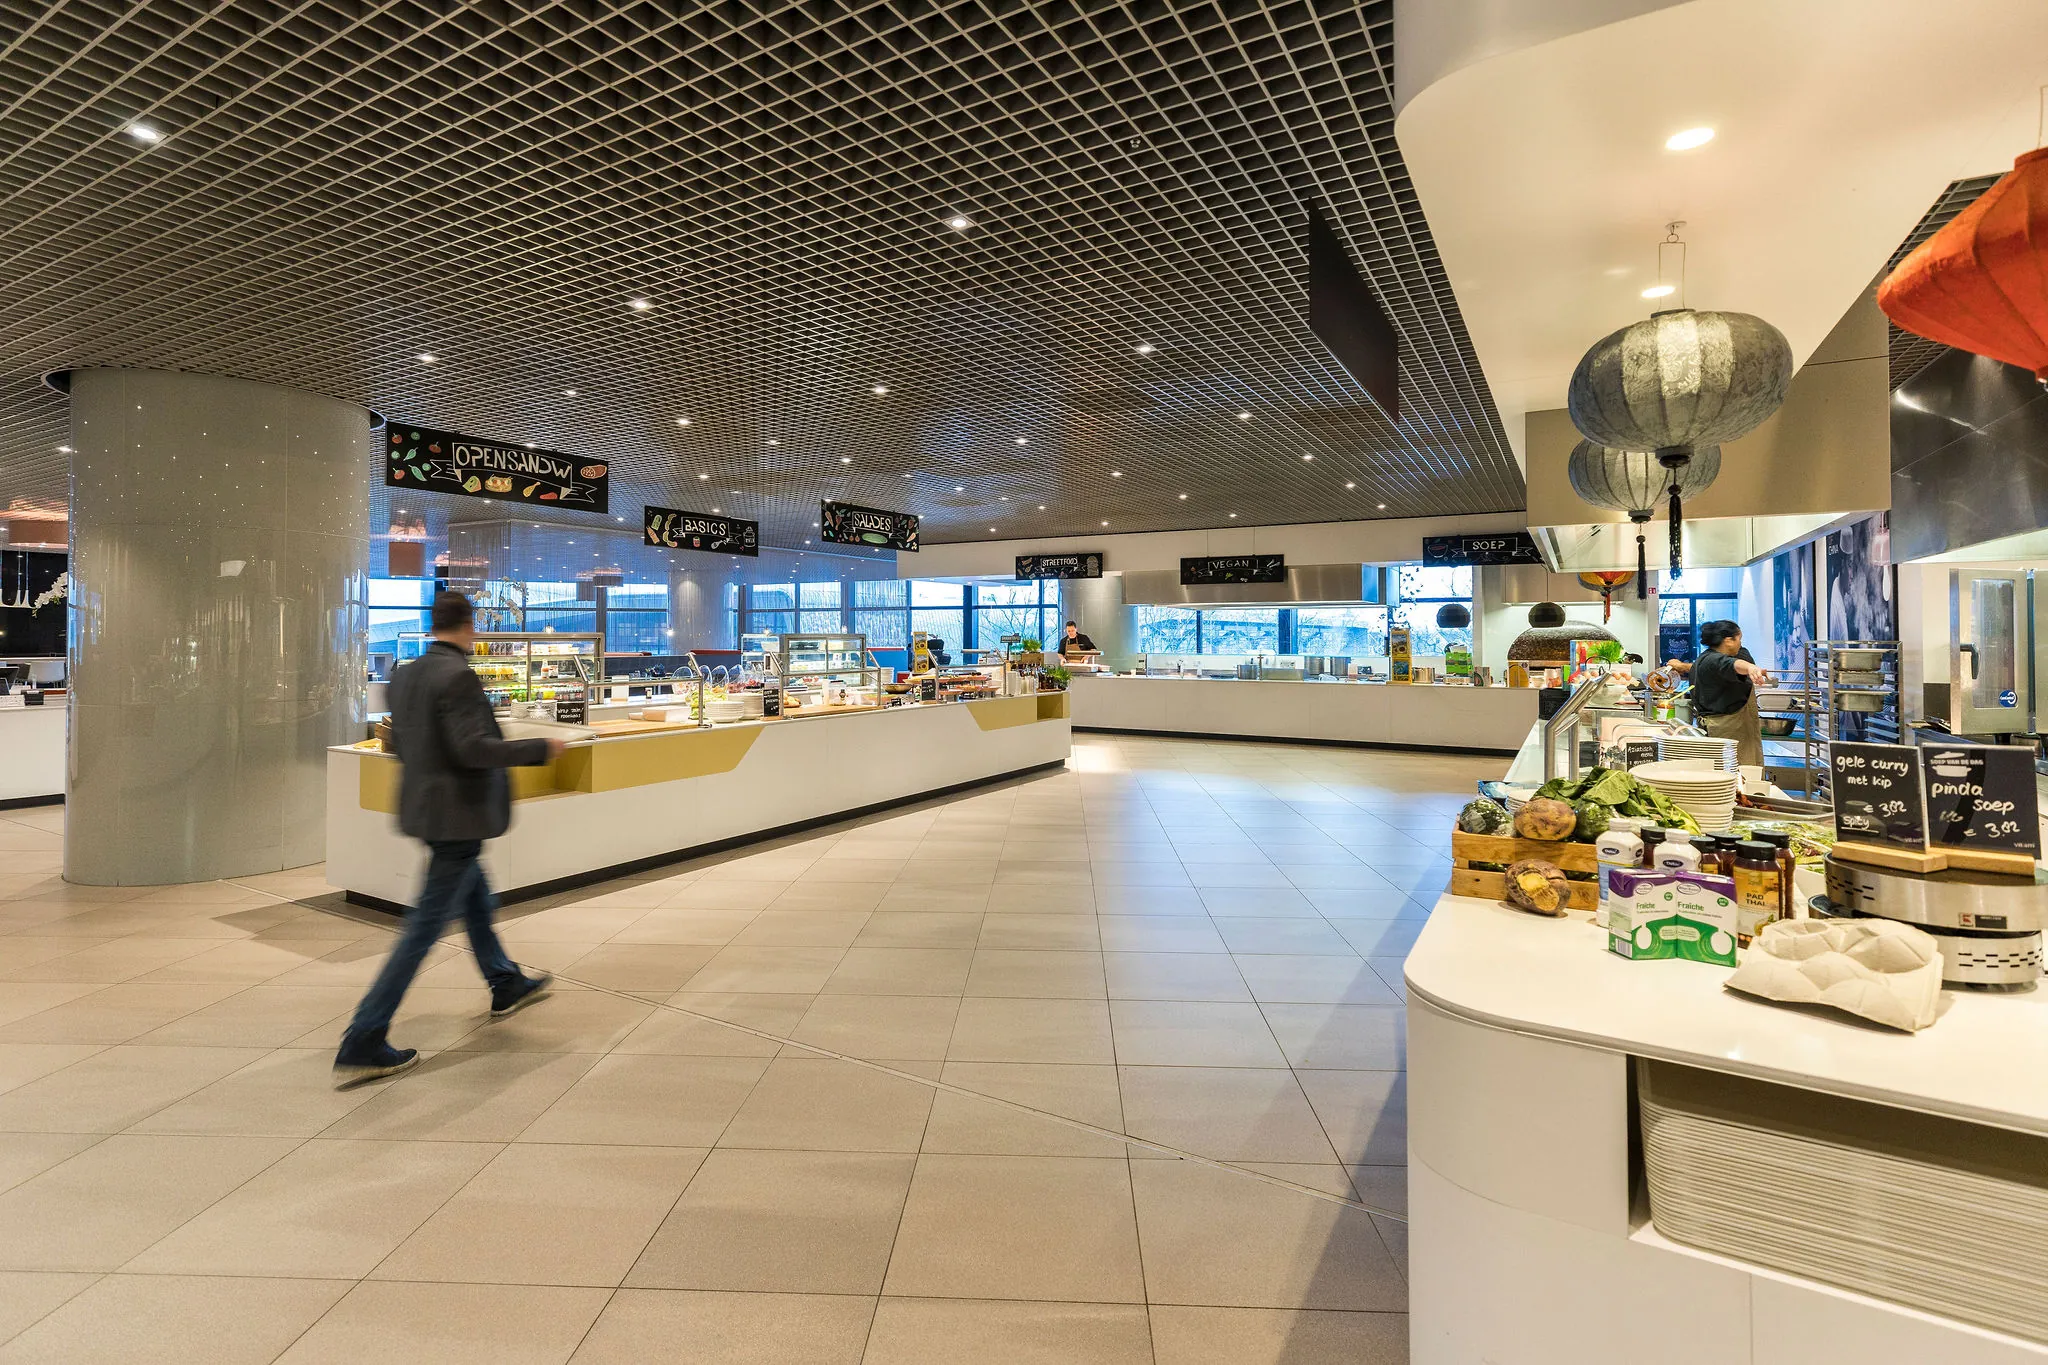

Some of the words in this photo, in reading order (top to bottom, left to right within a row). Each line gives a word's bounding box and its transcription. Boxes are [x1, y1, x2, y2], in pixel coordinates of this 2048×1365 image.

[456, 445, 571, 478] OPENSANDW
[684, 519, 727, 536] BASICS
[854, 513, 892, 531] SALADES
[1472, 540, 1506, 551] SOEP
[1212, 560, 1249, 570] VEGAN
[1836, 755, 1866, 772] gele
[1871, 759, 1909, 777] curry
[1848, 775, 1868, 786] met
[1872, 775, 1892, 789] kip
[1931, 782, 1983, 798] pinda
[1972, 799, 2015, 816] soep
